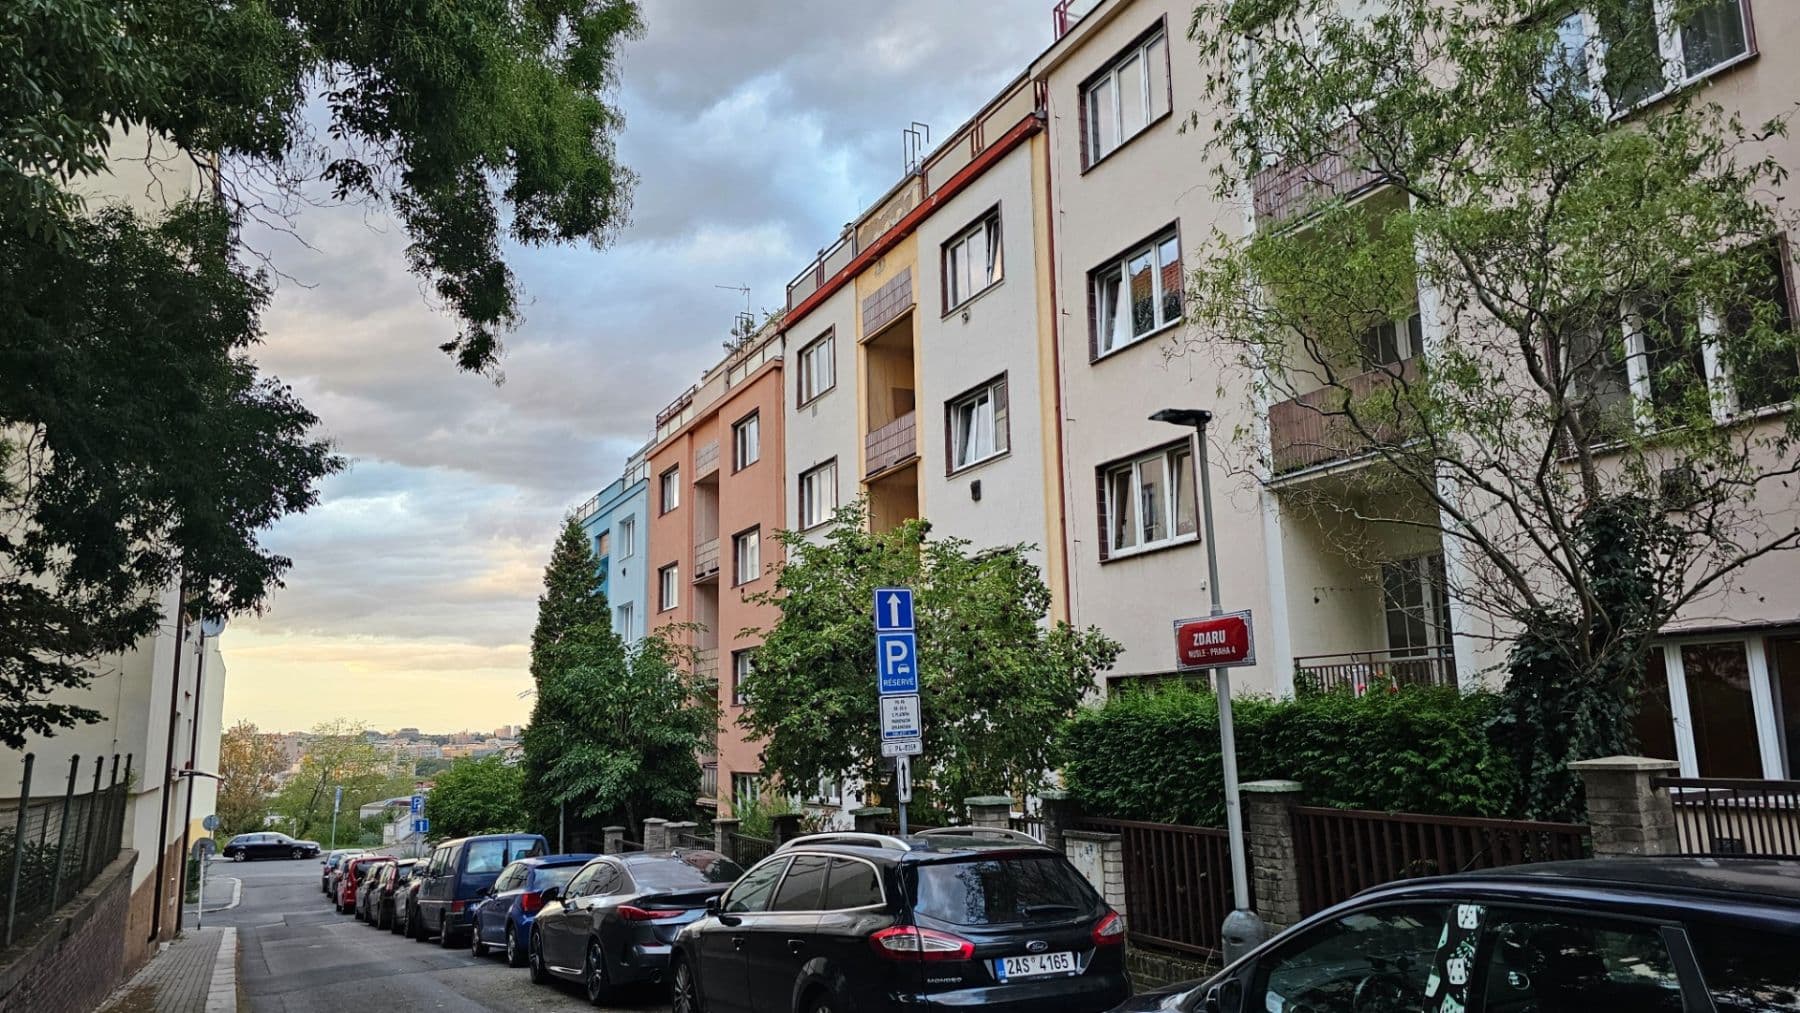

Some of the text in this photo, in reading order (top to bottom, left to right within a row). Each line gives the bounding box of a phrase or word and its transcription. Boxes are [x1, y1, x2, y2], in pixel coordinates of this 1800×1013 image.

[1193, 629, 1226, 647] ZDARU
[886, 640, 908, 675] P
[1210, 646, 1231, 656] PRAHA
[1231, 645, 1236, 654] 4
[1006, 953, 1069, 974] 2AS 4165
